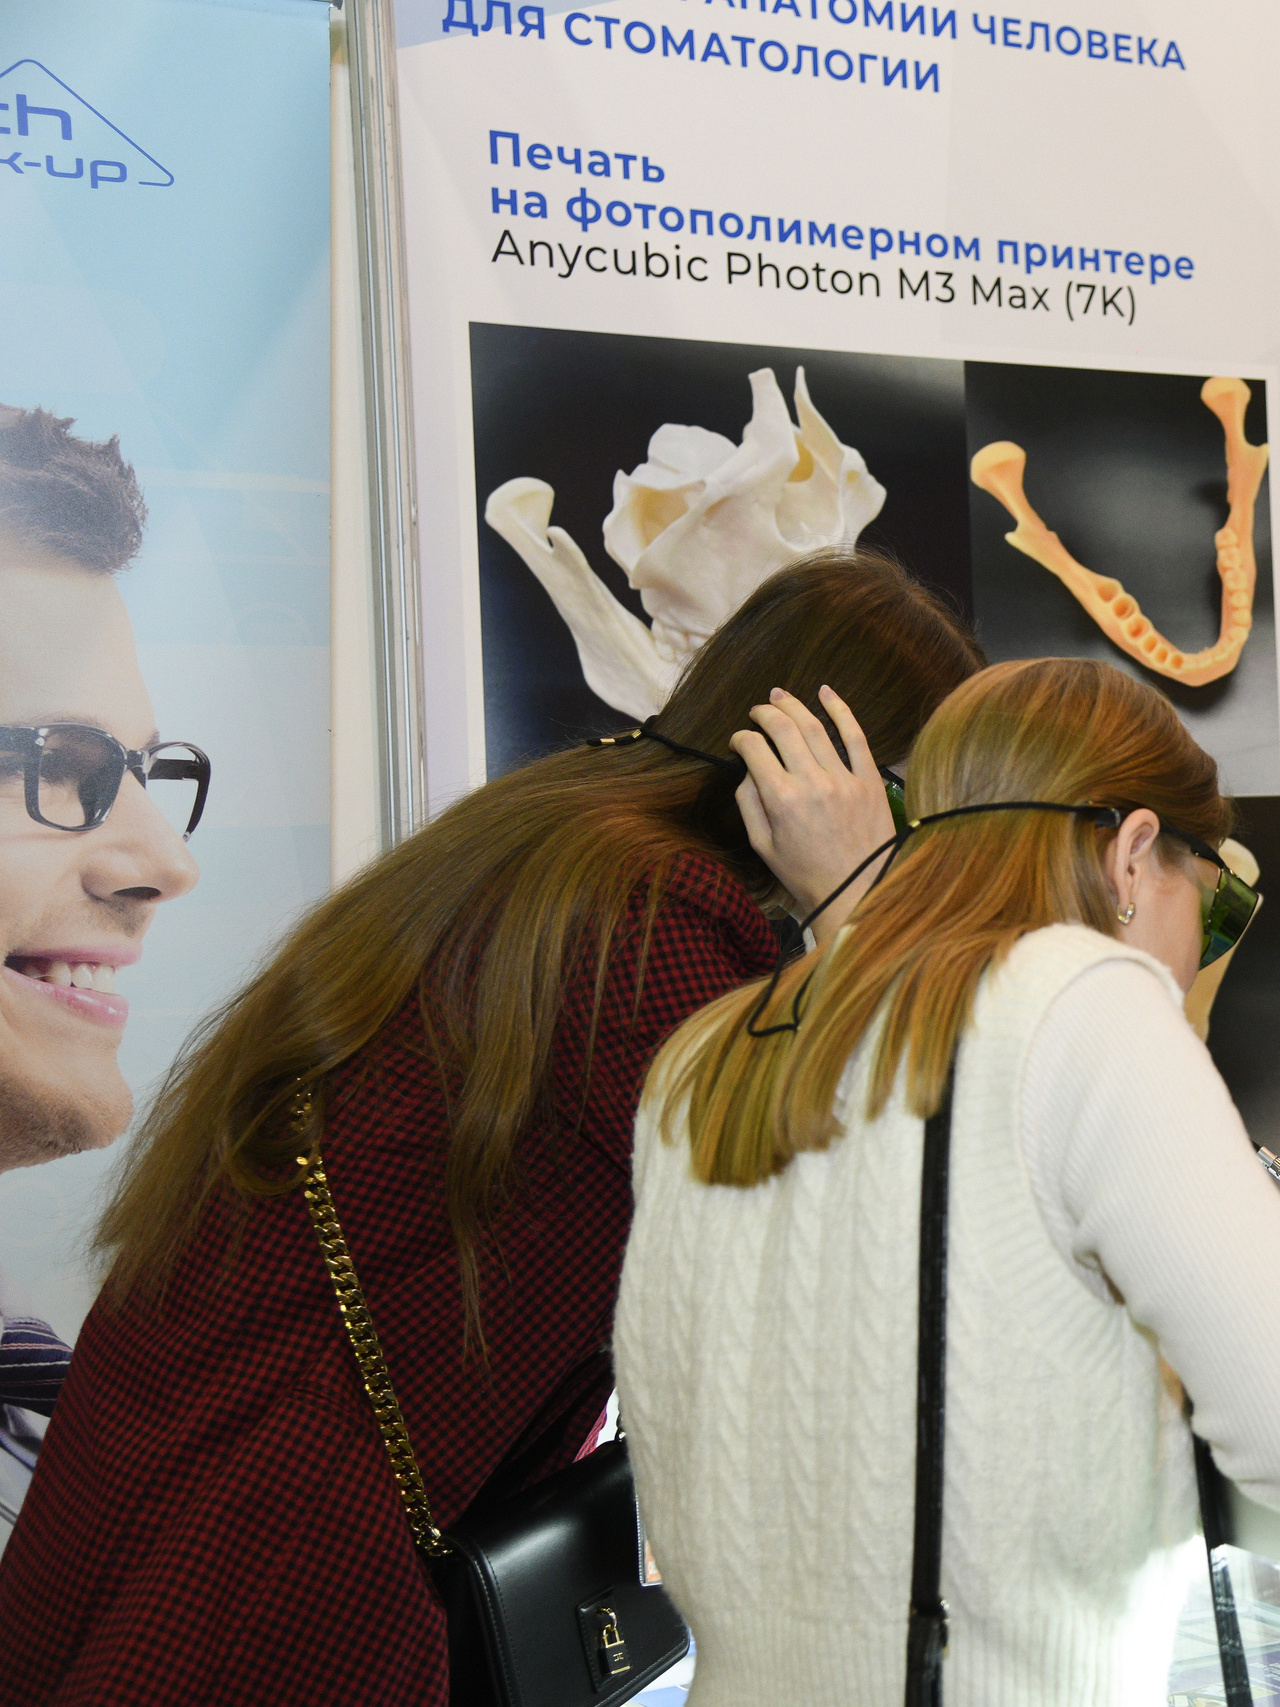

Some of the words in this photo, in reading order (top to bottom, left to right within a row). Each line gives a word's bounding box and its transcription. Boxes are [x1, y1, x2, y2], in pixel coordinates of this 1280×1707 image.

[442, 0, 546, 39] ДЛЯ
[564, 12, 940, 93] СТОМАТОЛОГИИ
[703, 0, 957, 39] АТОМИИ
[972, 13, 1186, 70] ЧЕЛОВЕКА
[0, 93, 72, 141] h
[489, 130, 665, 183] Печать
[491, 187, 548, 219] на
[566, 187, 980, 261] фотополимерном
[998, 240, 1194, 285] принтере
[492, 230, 708, 281] Anycubic
[727, 252, 880, 298] Photon
[900, 268, 955, 303] M3
[972, 275, 1050, 311] Max
[1066, 281, 1135, 325] (7K)
